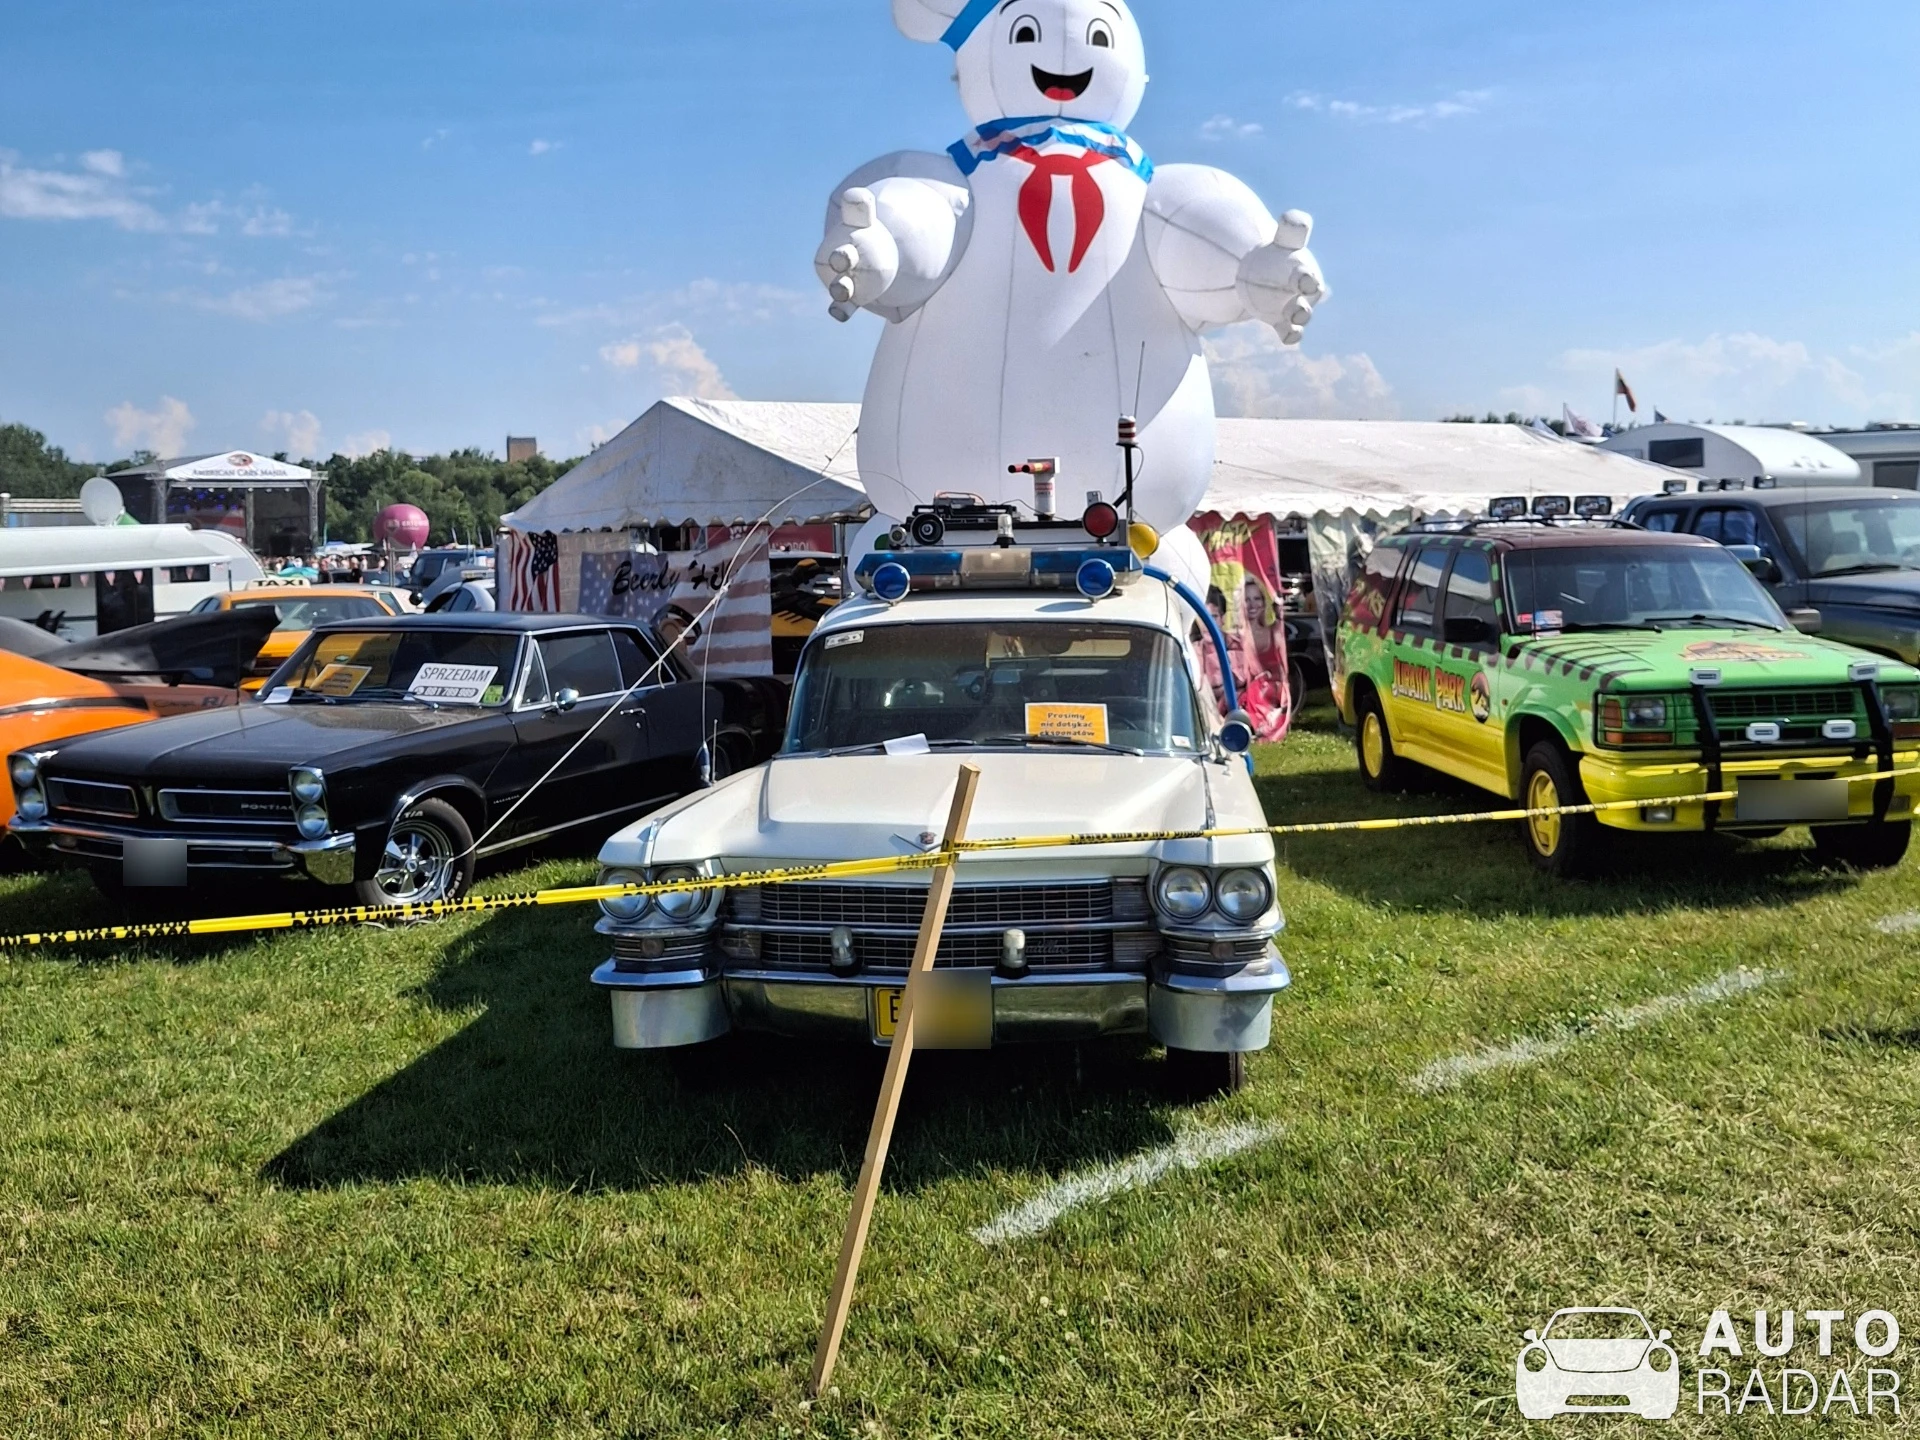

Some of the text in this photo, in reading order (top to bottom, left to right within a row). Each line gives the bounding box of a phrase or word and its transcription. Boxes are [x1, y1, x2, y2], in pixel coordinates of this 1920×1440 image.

[253, 579, 303, 587] TAXI
[420, 666, 491, 683] SPRZEDAM
[1435, 665, 1466, 713] PARK
[1048, 712, 1086, 721] Prosimy
[1040, 720, 1093, 729] nie dotykać
[404, 810, 424, 818] T/A
